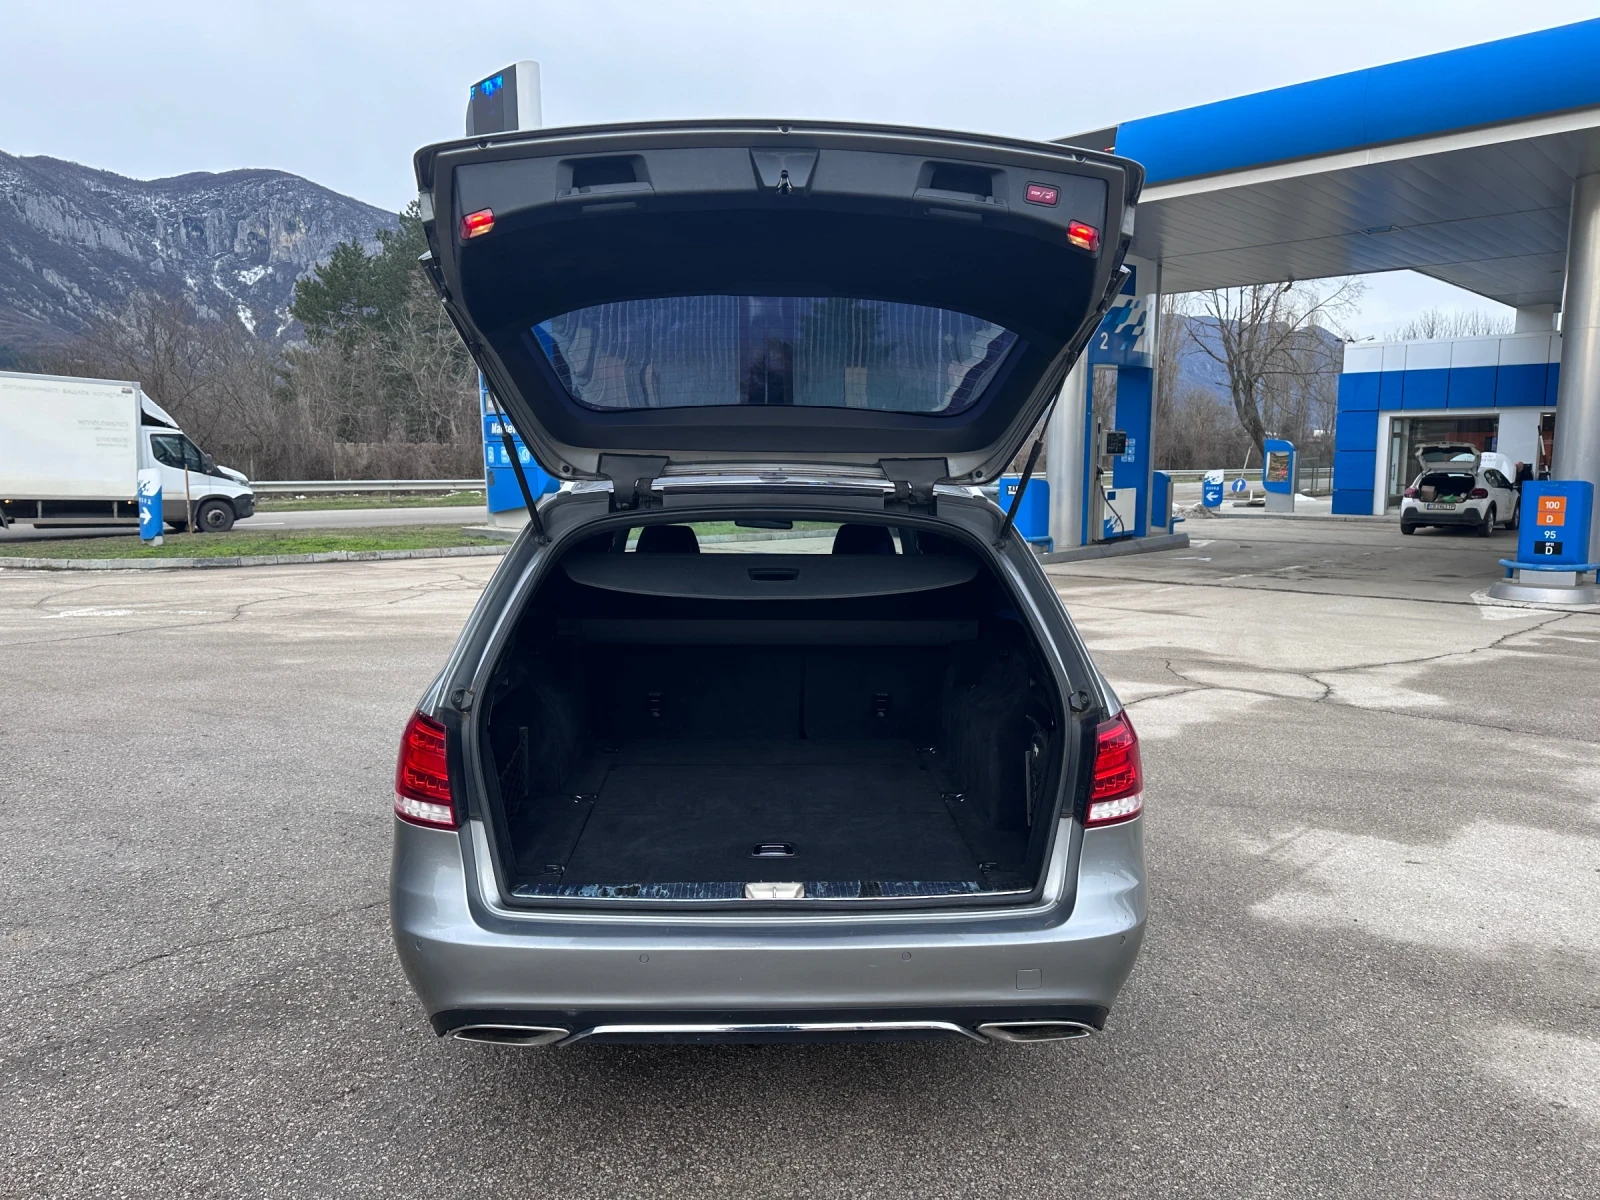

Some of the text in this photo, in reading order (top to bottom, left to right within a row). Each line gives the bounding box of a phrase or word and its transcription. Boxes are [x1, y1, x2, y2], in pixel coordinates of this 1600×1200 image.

[1100, 331, 1109, 350] 2
[1545, 500, 1560, 510] 100
[1545, 514, 1554, 524] D
[1544, 530, 1557, 540] 95
[1545, 546, 1553, 555] D
